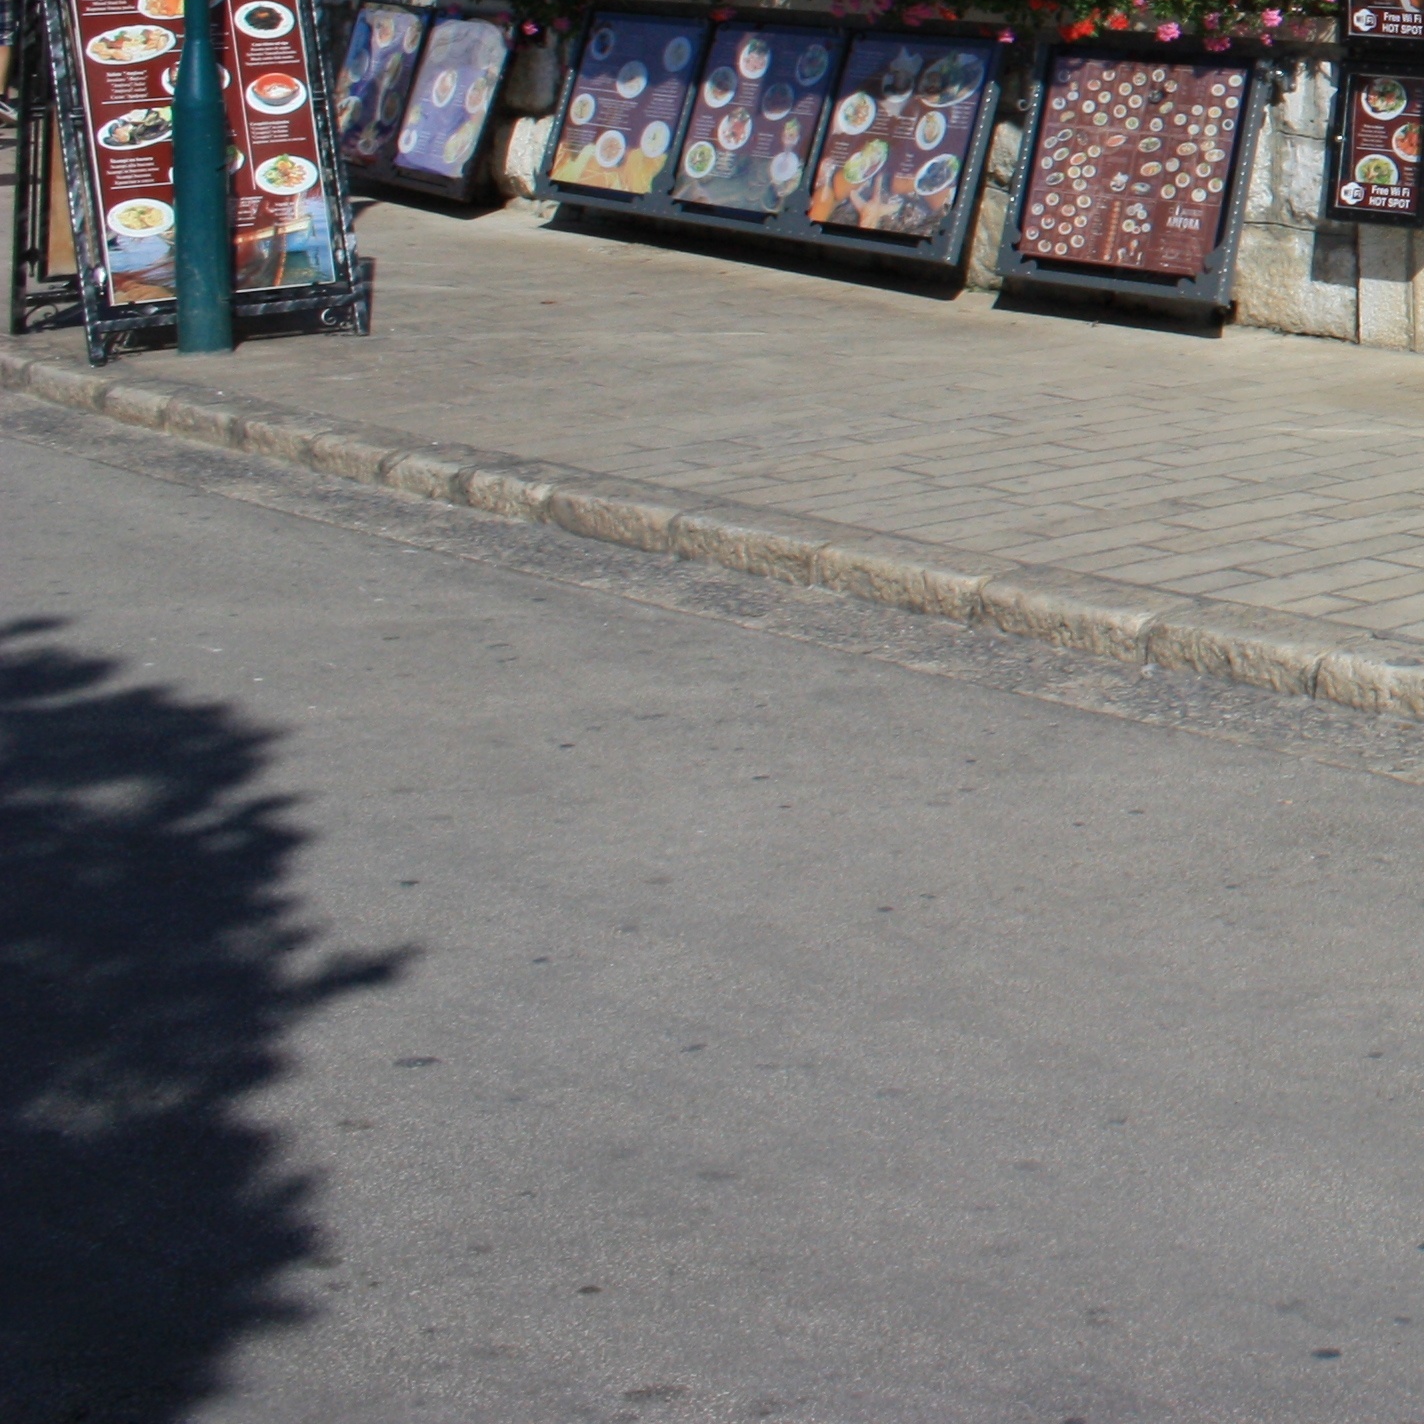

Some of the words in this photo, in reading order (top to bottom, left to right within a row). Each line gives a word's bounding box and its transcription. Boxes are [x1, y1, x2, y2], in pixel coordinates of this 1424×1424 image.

[1383, 12, 1402, 24] Free
[1415, 14, 1423, 25] Fi
[1382, 23, 1401, 35] HOT
[1402, 24, 1424, 36] SPOT
[1370, 185, 1389, 196] Free
[1402, 187, 1411, 198] Fi
[1368, 196, 1387, 207] HOT
[1388, 198, 1411, 209] SPOT
